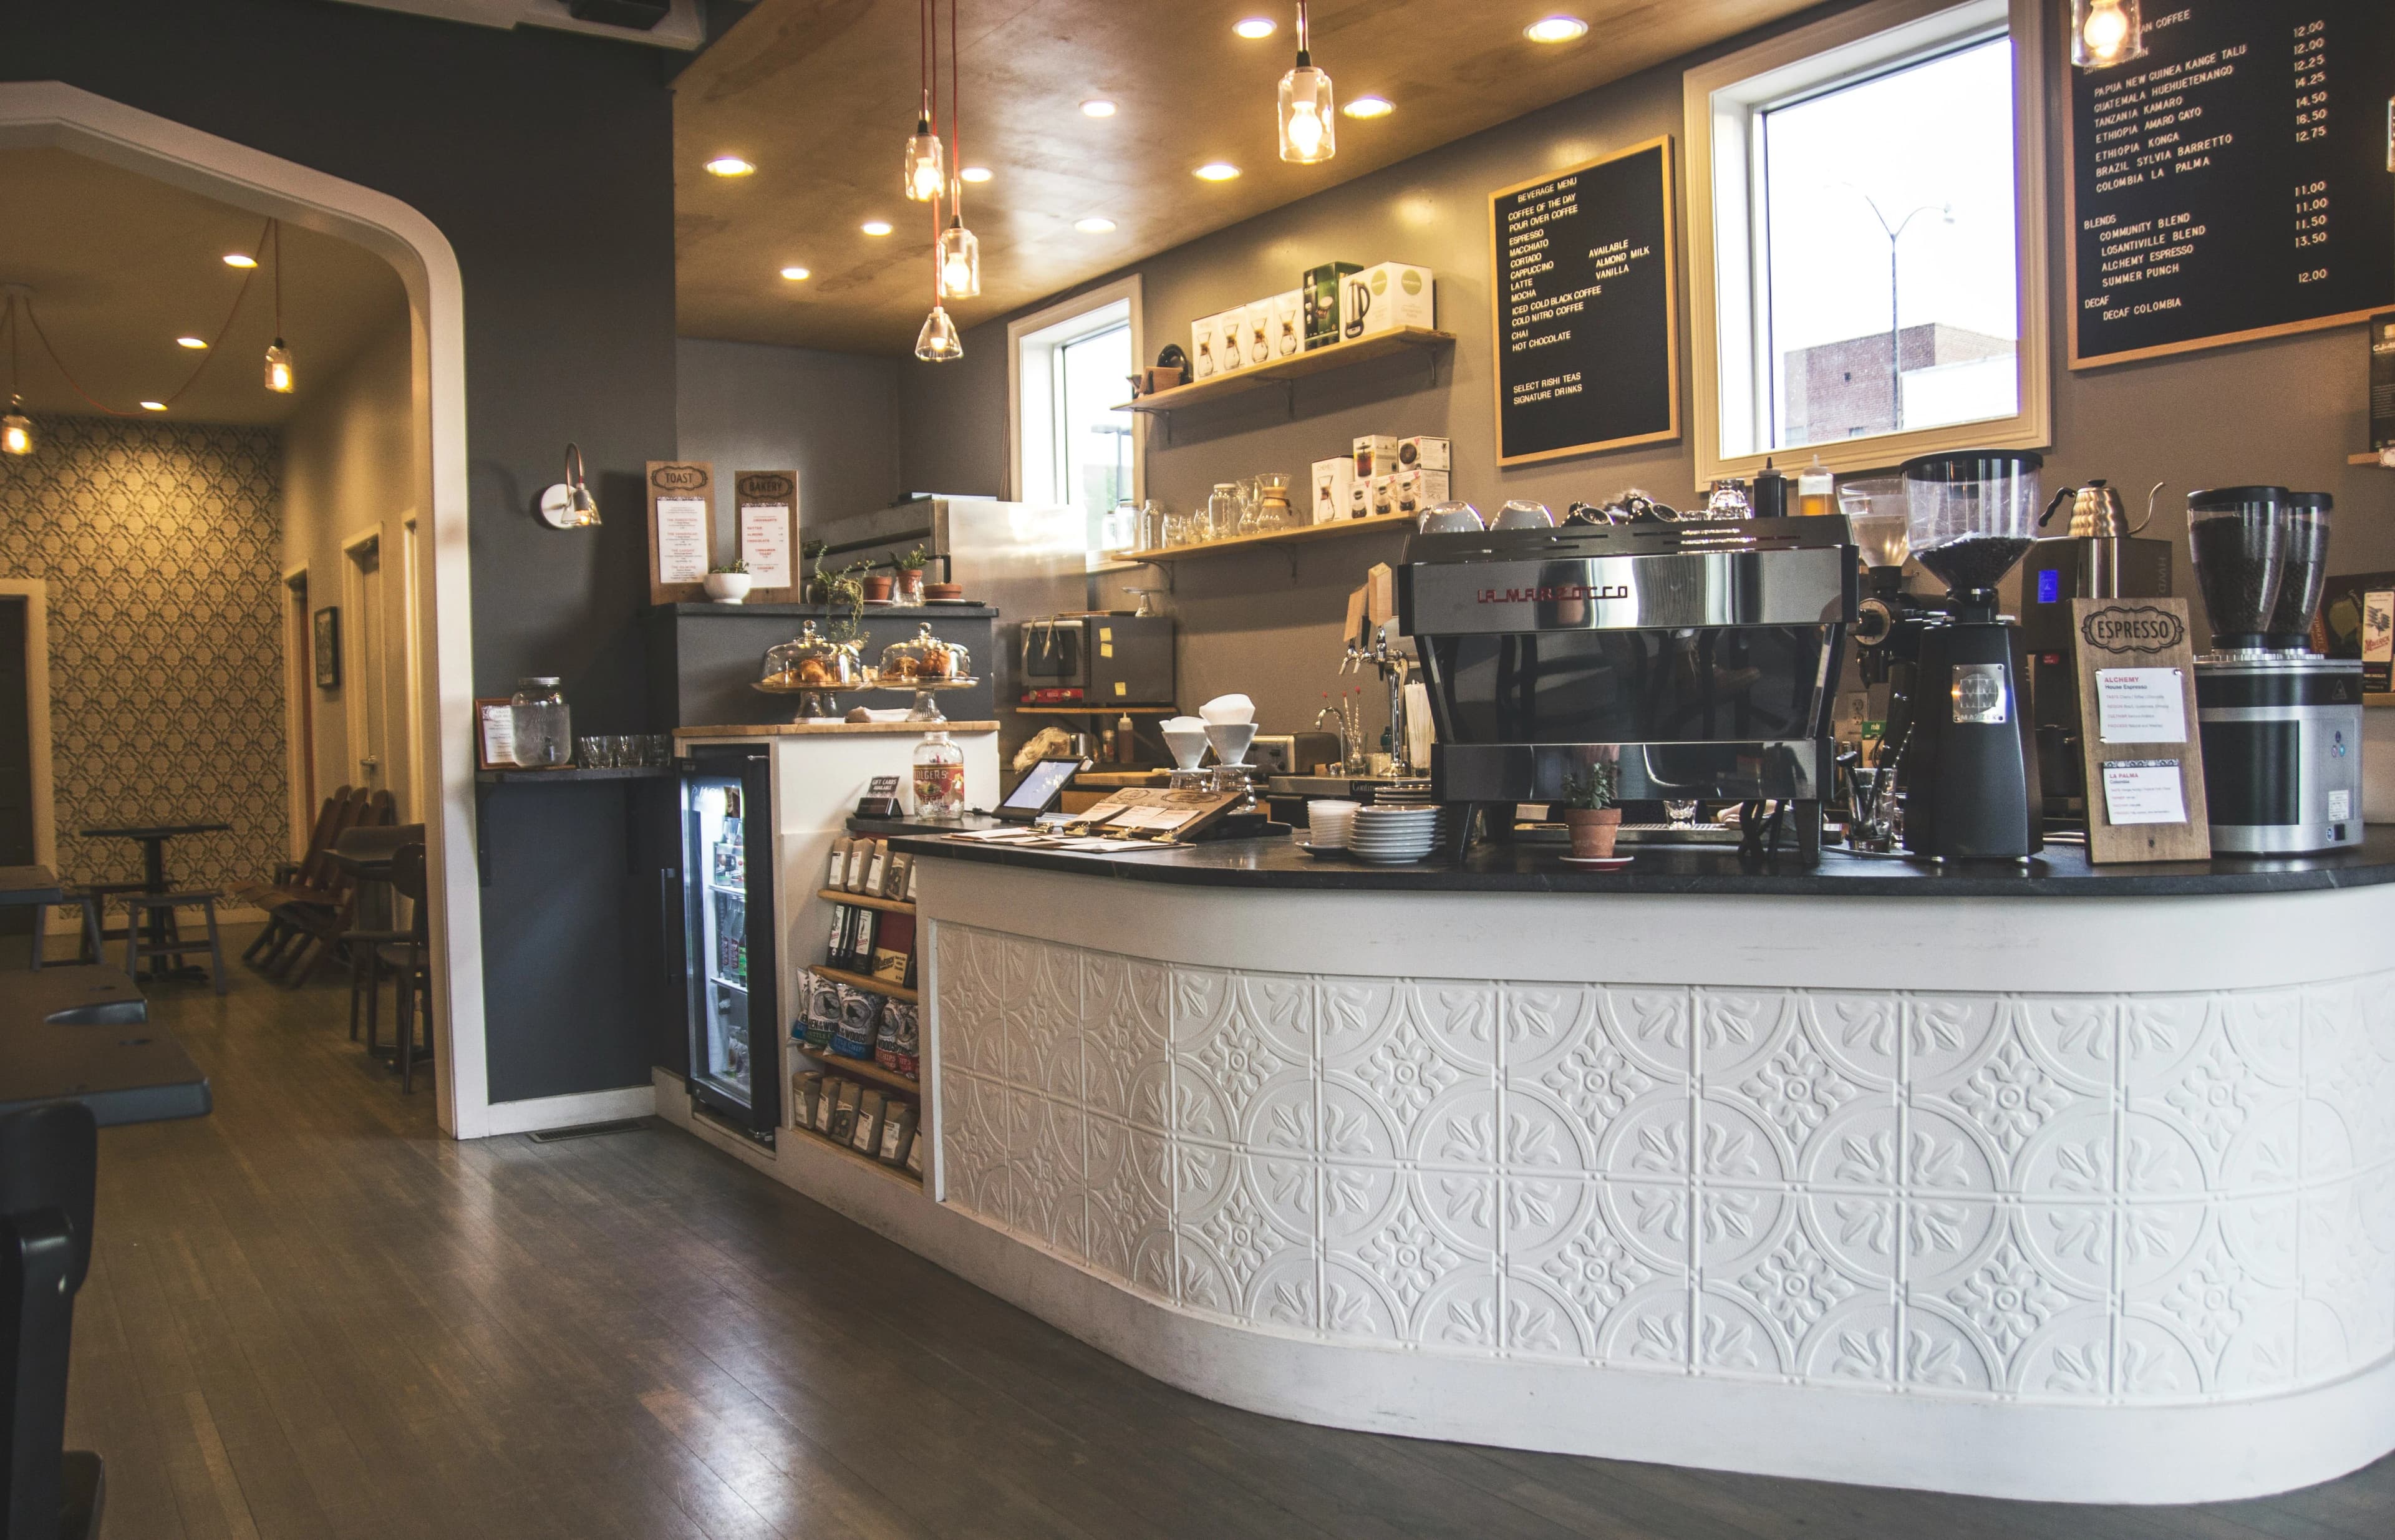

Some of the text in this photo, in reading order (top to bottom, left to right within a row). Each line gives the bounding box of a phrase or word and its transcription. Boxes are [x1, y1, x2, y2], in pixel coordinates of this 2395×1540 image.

[2156, 9, 2190, 29] COFFEE
[2094, 20, 2325, 97] PAPUA NEW GUINEA KANGE TALU 12.00
[2094, 37, 2325, 114] GUATEMALA HUEHUETENANGO 12.00
[2094, 54, 2325, 128] TANZANIA KAMARO 12.25
[2096, 72, 2326, 144] ETHIOPIA AMARO GAYO 14.25
[2096, 91, 2327, 162] ETHIOPIA KONGA 14.50
[2096, 161, 2129, 178] BRAZIL
[2137, 150, 2172, 168] SYLVIA
[2178, 133, 2233, 157] BARRETTO
[2096, 125, 2327, 193] COLOMBIA LA PALMA 12.75
[1518, 177, 1577, 203] BEVERAGE MENU
[1508, 193, 1576, 221] COFFEE OF THE DAY
[2099, 181, 2326, 242] COMMUNITY BLEND 11.00
[1509, 205, 1578, 232] POUR OVER COFFEE
[2084, 215, 2116, 231] BLENDS
[2101, 198, 2327, 257] LOSANTIVILLE BLEND 11.00
[1509, 229, 1544, 245] ESPRESSO
[1509, 239, 1549, 256] MACCHIATO
[2101, 215, 2327, 272] ALCHEMY ESPRESSO 11.50
[1589, 240, 1628, 258] AVAILABLE
[1596, 246, 1650, 268] ALMOND MILK
[2102, 232, 2327, 288] SUMMER PUNCH 13.50
[1511, 253, 1542, 268] CORTADO
[1511, 261, 1554, 279] CAPPUCCINO
[1596, 264, 1629, 279] VANILLA
[1511, 278, 1533, 291] LATTE
[1511, 289, 1536, 302] MOCHA
[2103, 269, 2327, 321] DECAF COLOMBIA 12.00
[1512, 286, 1602, 315] ICED COLD BLACK COFFEE
[2084, 296, 2109, 309] DECAF
[1512, 302, 1584, 327] COLD NITRO COFFEE
[1512, 329, 1528, 340] CHAI
[1512, 331, 1571, 352] HOT CHOCOLATE
[1514, 372, 1581, 394] SELECT RISHI TEAS
[1514, 384, 1582, 405] SIGNATURE DRINKS
[665, 473, 694, 483] TOAST
[750, 482, 783, 492] BAKERY
[1478, 589, 1496, 603] LA
[2098, 621, 2169, 639] ESPRESSO
